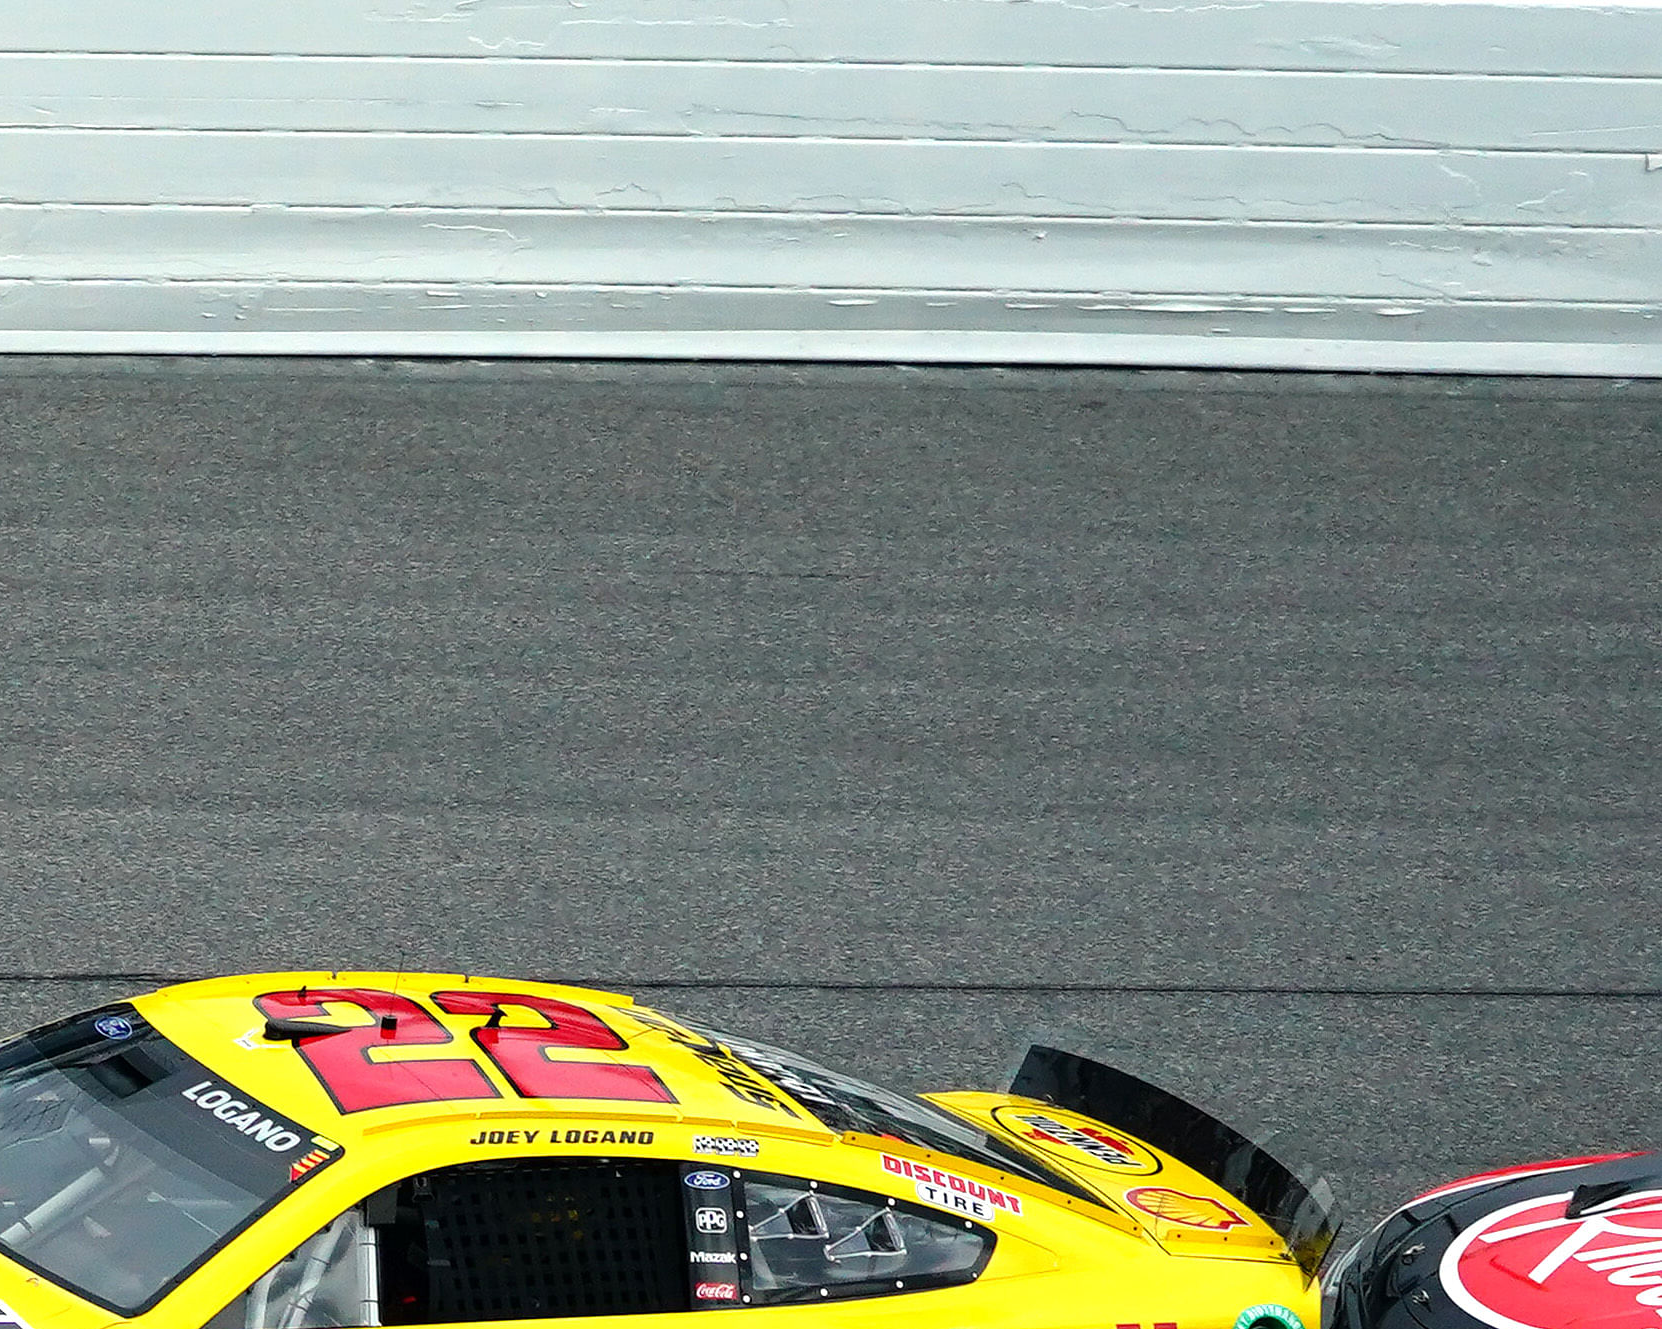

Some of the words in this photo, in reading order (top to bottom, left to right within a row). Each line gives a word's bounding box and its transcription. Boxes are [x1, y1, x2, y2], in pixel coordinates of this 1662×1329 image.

[251, 986, 680, 1116] 22
[181, 1080, 302, 1153] LOGANO
[469, 1129, 540, 1145] JOEY
[549, 1129, 655, 1145] LOGANO
[881, 1154, 1022, 1215] DISCOUNT
[925, 1186, 986, 1217] TIRE
[698, 1210, 727, 1230] PPG
[690, 1251, 737, 1264] Mazak
